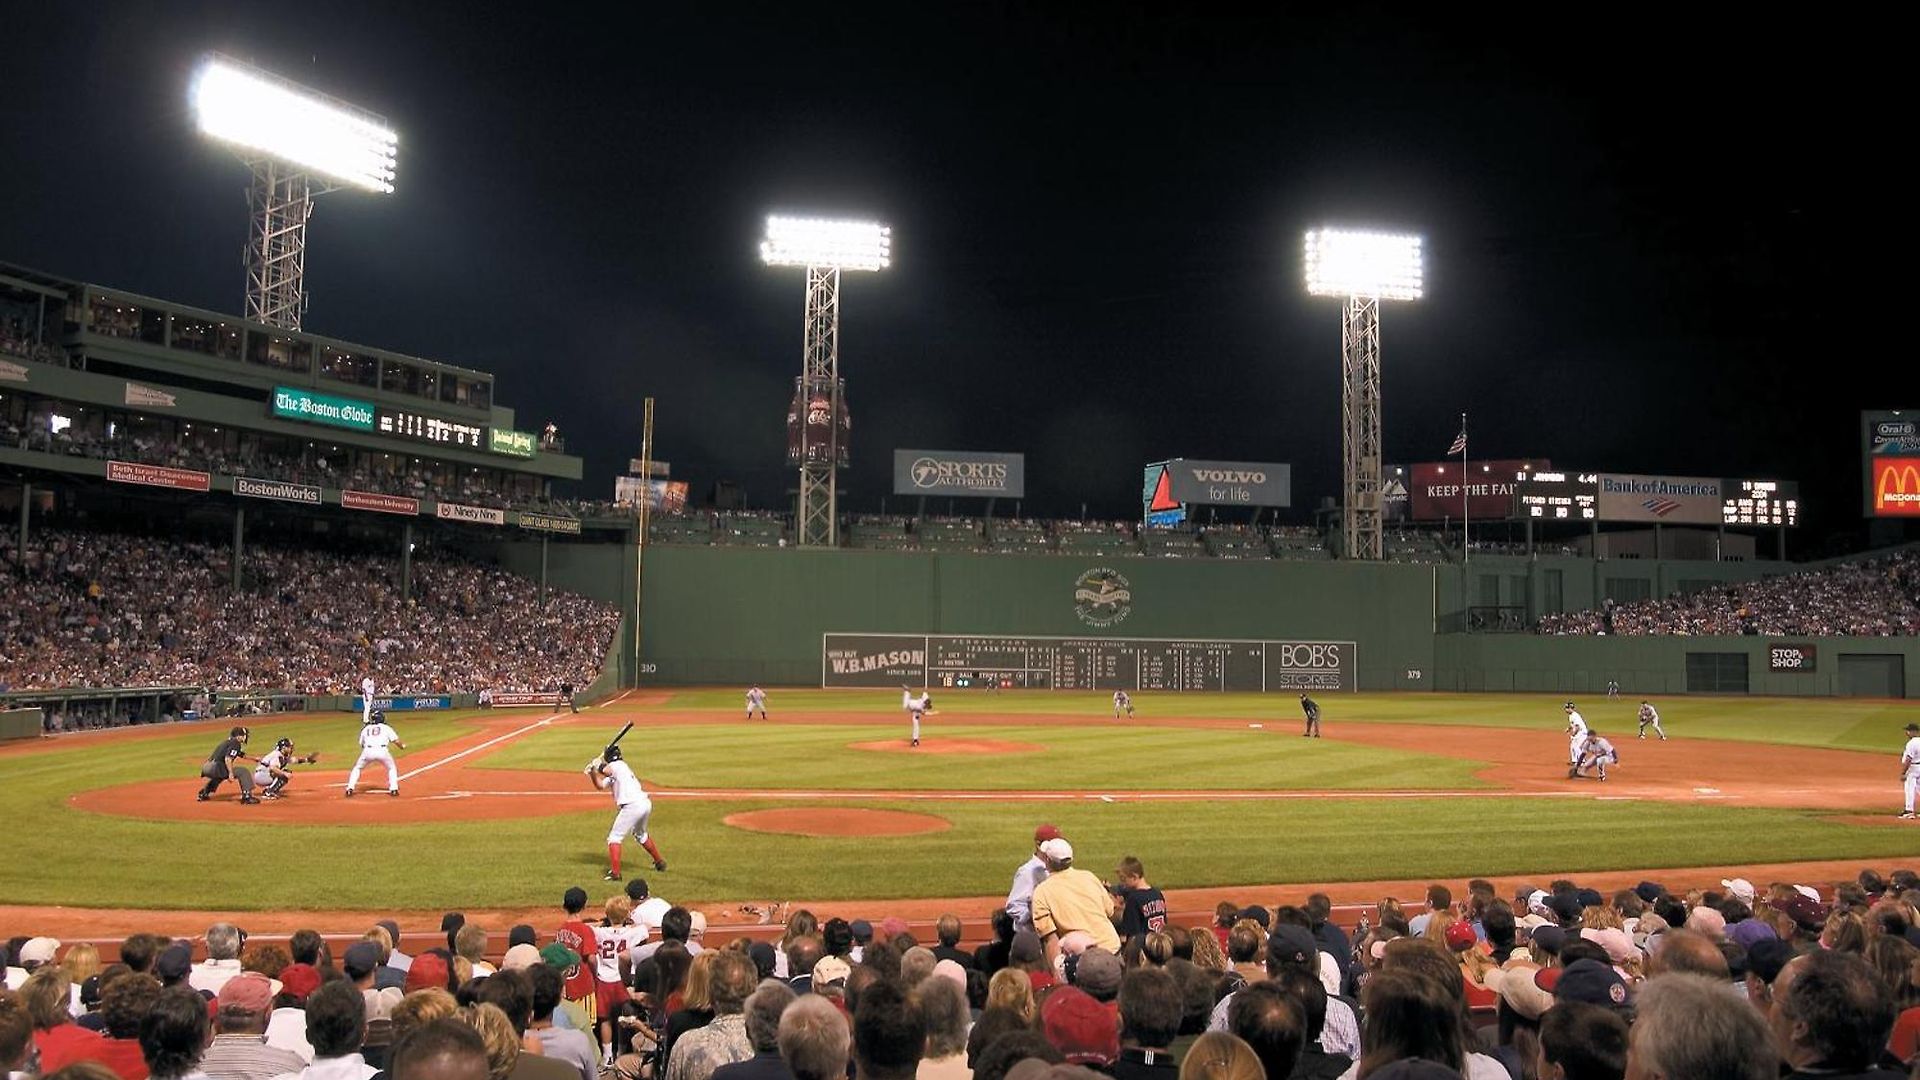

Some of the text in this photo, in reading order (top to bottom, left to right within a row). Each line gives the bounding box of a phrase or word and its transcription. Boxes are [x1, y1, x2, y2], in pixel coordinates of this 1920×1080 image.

[276, 393, 372, 424] The Boston Globe
[427, 428, 434, 439] 2
[443, 430, 449, 441] 2
[458, 433, 464, 444] 0
[113, 465, 206, 482] Beth Israel Deaconess
[938, 461, 1006, 478] SPORTS
[1192, 470, 1266, 484] VOLVO
[112, 472, 176, 484] Medical Center
[938, 477, 1004, 487] AUTHORITY
[238, 480, 317, 500] BostonWorks
[1210, 486, 1250, 502] for life
[1428, 483, 1517, 497] KEEP THE FAI
[1603, 478, 1718, 496] Bank of America
[454, 506, 496, 520] Ninety Nine
[832, 650, 924, 673] W.B.MASON
[1282, 645, 1340, 668] BOB'S
[1772, 649, 1799, 659] STOP
[602, 939, 627, 960] 24
